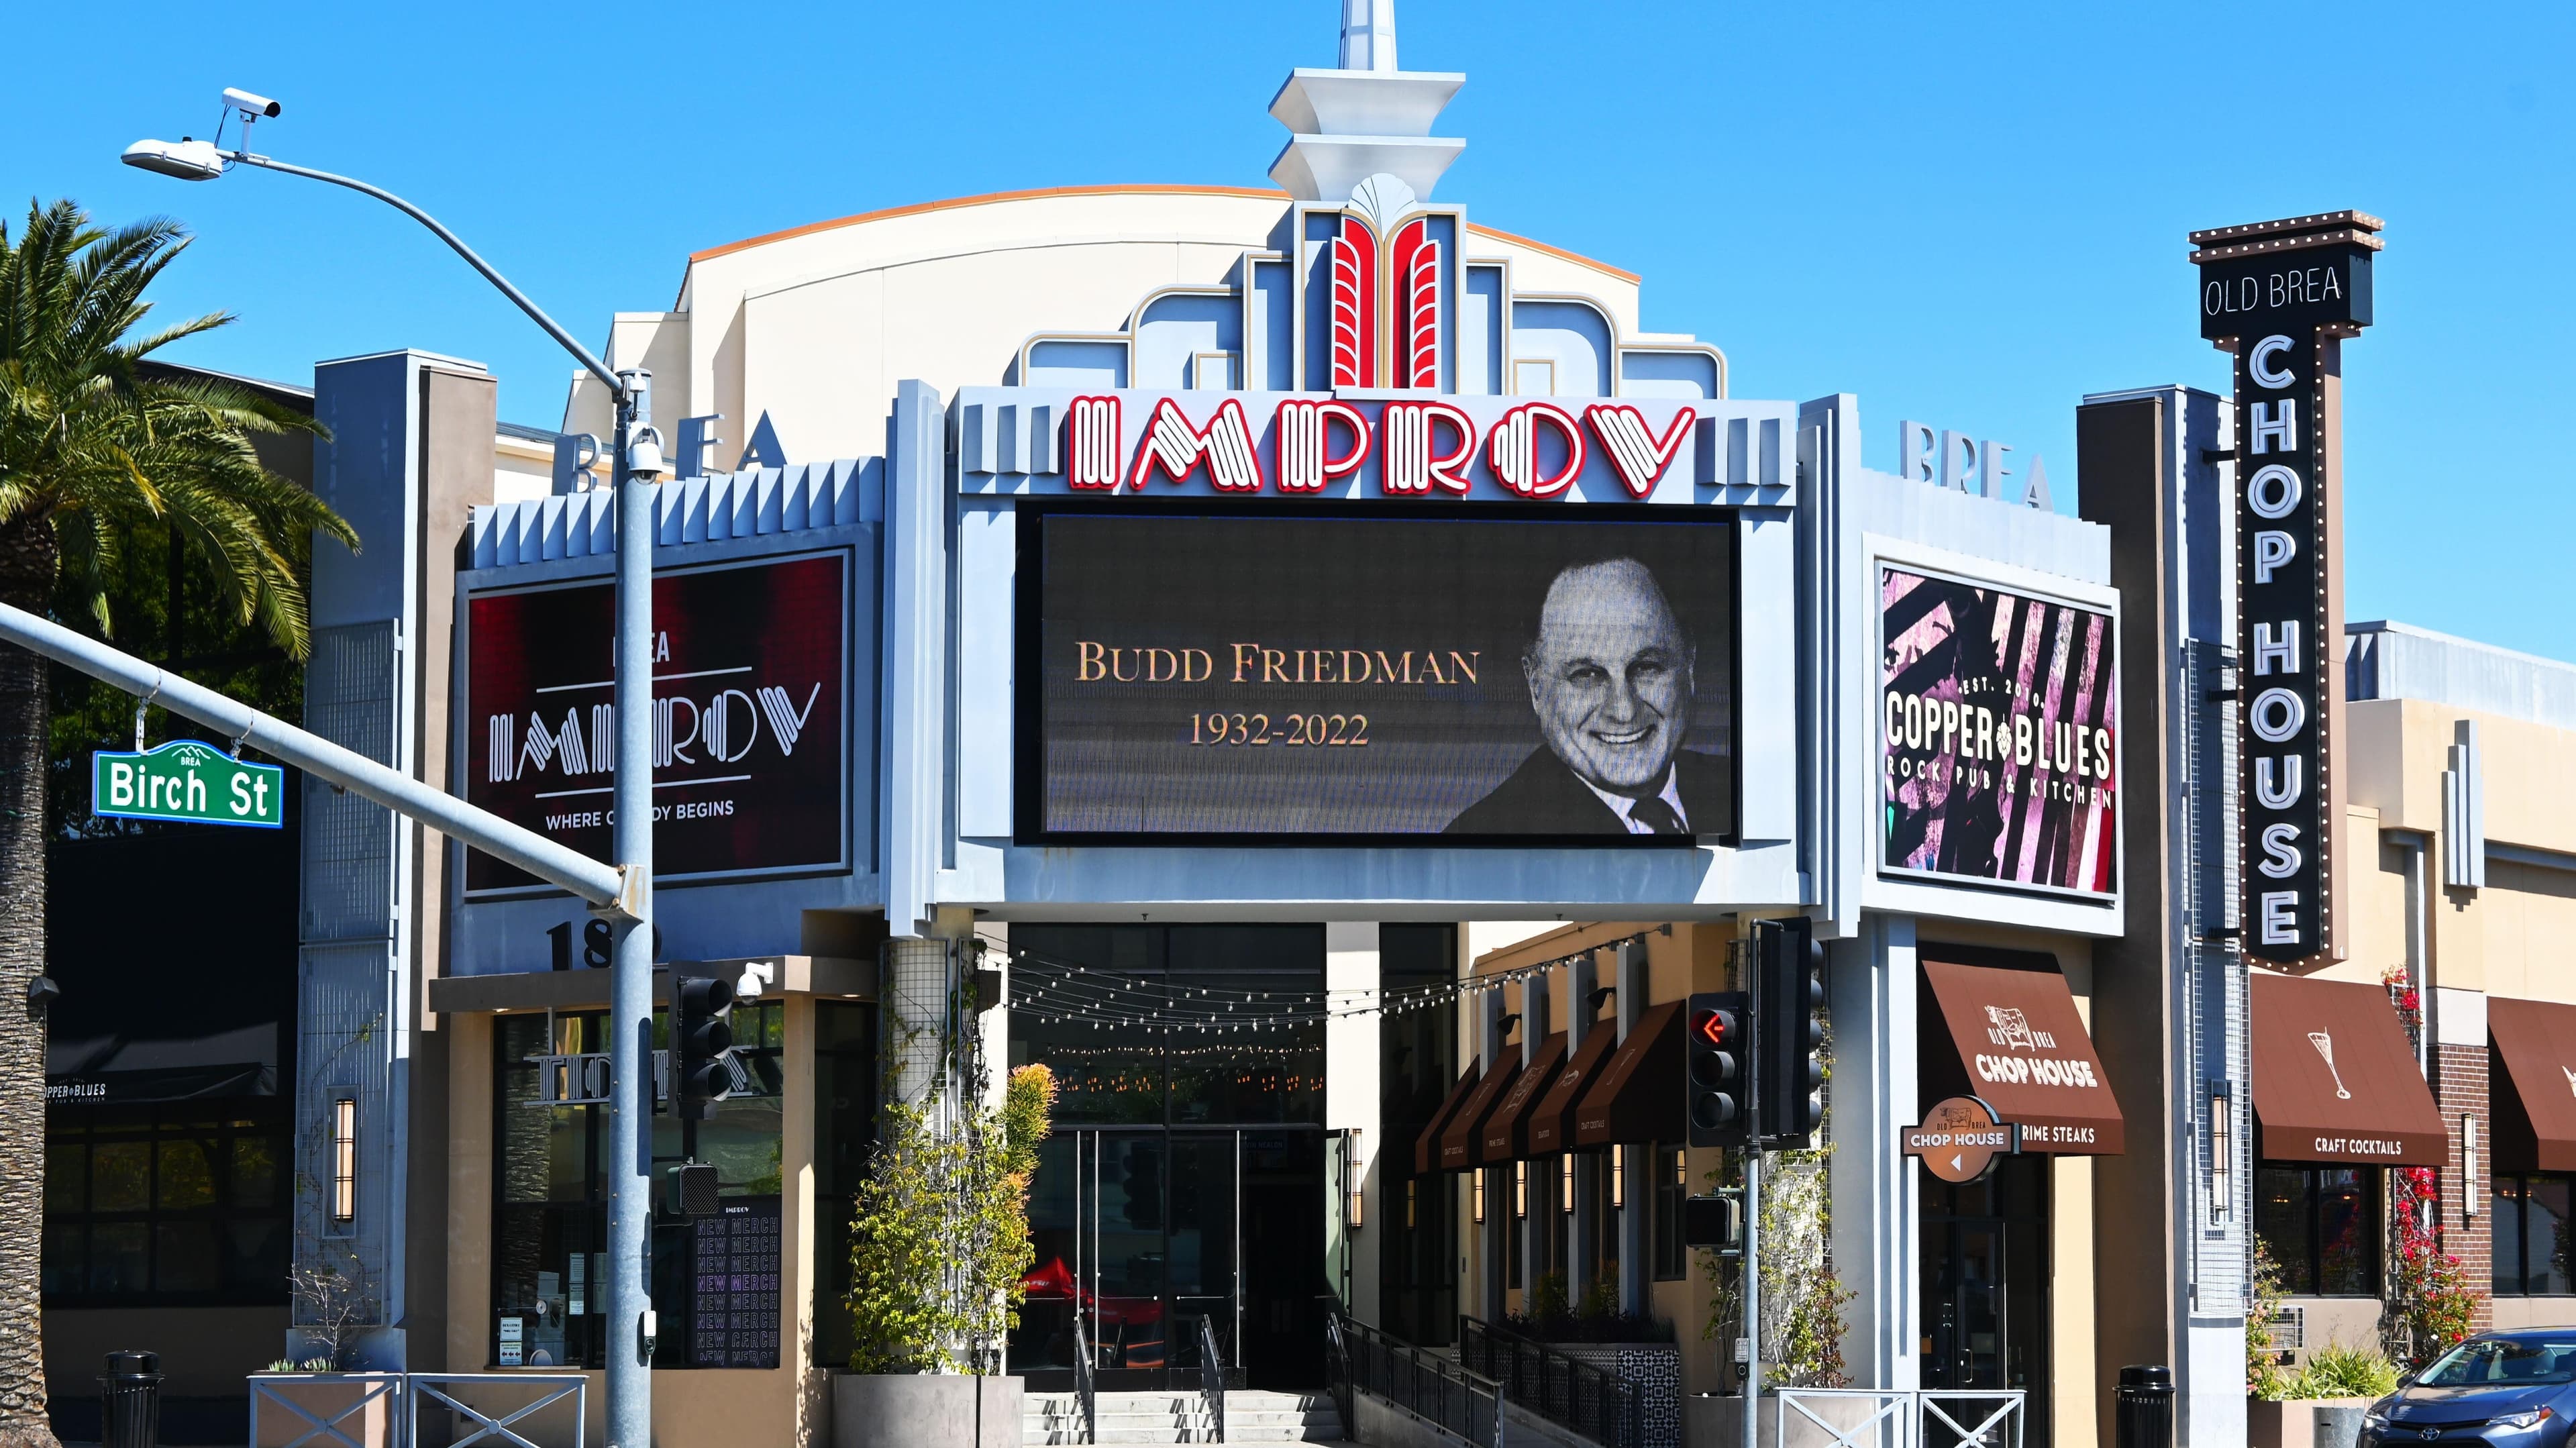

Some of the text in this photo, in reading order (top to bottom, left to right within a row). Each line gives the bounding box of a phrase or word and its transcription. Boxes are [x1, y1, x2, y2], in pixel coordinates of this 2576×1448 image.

[2205, 266, 2342, 316] OLD BREA
[552, 408, 787, 497] BEA
[1068, 395, 1696, 499] IMPROV
[2247, 333, 2303, 584] CHOP
[1900, 420, 2054, 511] BREA
[1189, 713, 1370, 746] 1932-2022
[1886, 690, 2110, 780] COPPER BLUES
[181, 756, 201, 767] BREA
[110, 762, 268, 817] Birch St
[1887, 755, 2112, 810] ROCK PUB & KITCHEN
[2250, 619, 2306, 946] HOUSE
[545, 811, 602, 831] WHERE
[676, 800, 735, 821] BEGINS
[546, 919, 662, 972] 18
[1987, 1027, 2057, 1049] OLD BREA
[1975, 1053, 2098, 1088] CHOP HOUSE
[74, 1083, 106, 1097] BLUES
[1910, 1133, 2004, 1147] CHOP HOUSE
[2022, 1125, 2095, 1143] RIME STEAKS
[2315, 1137, 2402, 1155] CRAFT COCKTAILS
[697, 1217, 778, 1235] NEW MERCH
[697, 1236, 778, 1254] NEW MERCH
[697, 1255, 778, 1273] NEW MERCH
[697, 1274, 778, 1292] NEW MERCH
[697, 1293, 778, 1310] NEW MERCH
[697, 1312, 778, 1329] NEW MERCH
[697, 1332, 726, 1349] NEW
